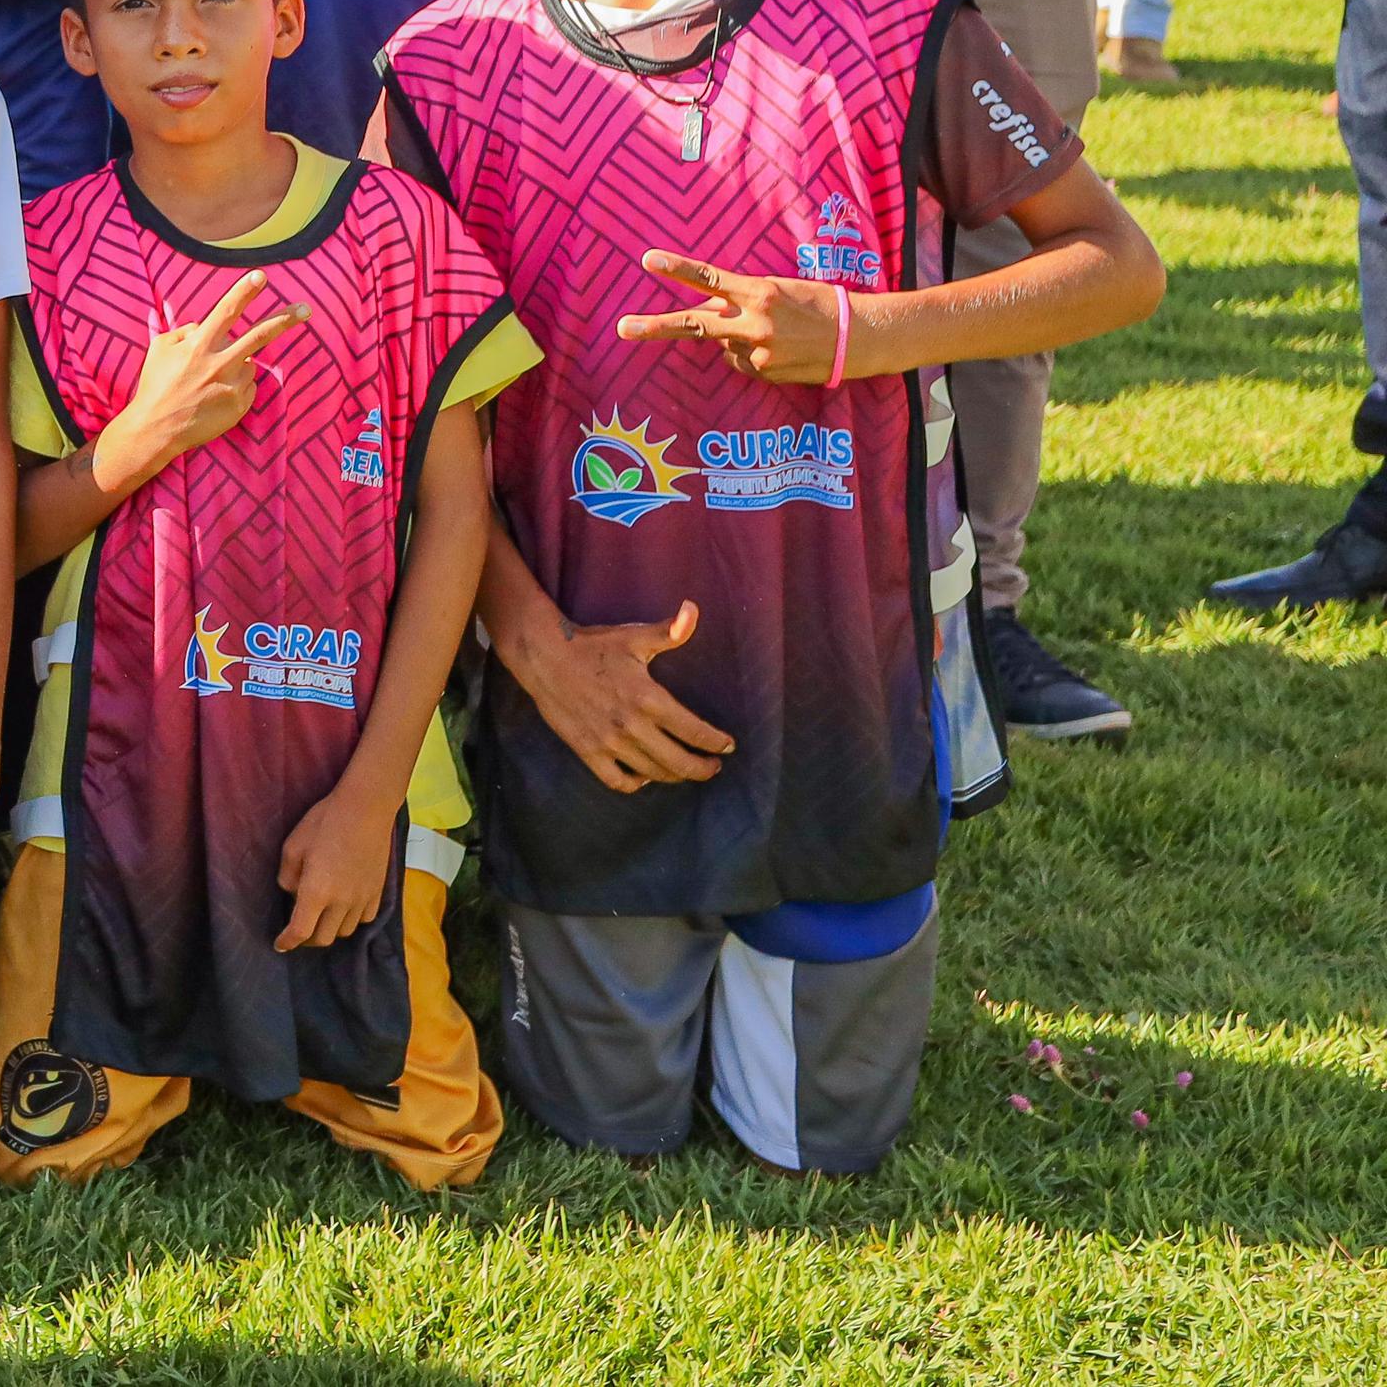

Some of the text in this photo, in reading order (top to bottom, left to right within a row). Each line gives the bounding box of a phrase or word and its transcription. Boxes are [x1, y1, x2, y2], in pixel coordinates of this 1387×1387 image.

[972, 80, 1051, 169] crefisa
[697, 422, 854, 469] CURRAIS
[287, 669, 353, 693] MUNICIPA
